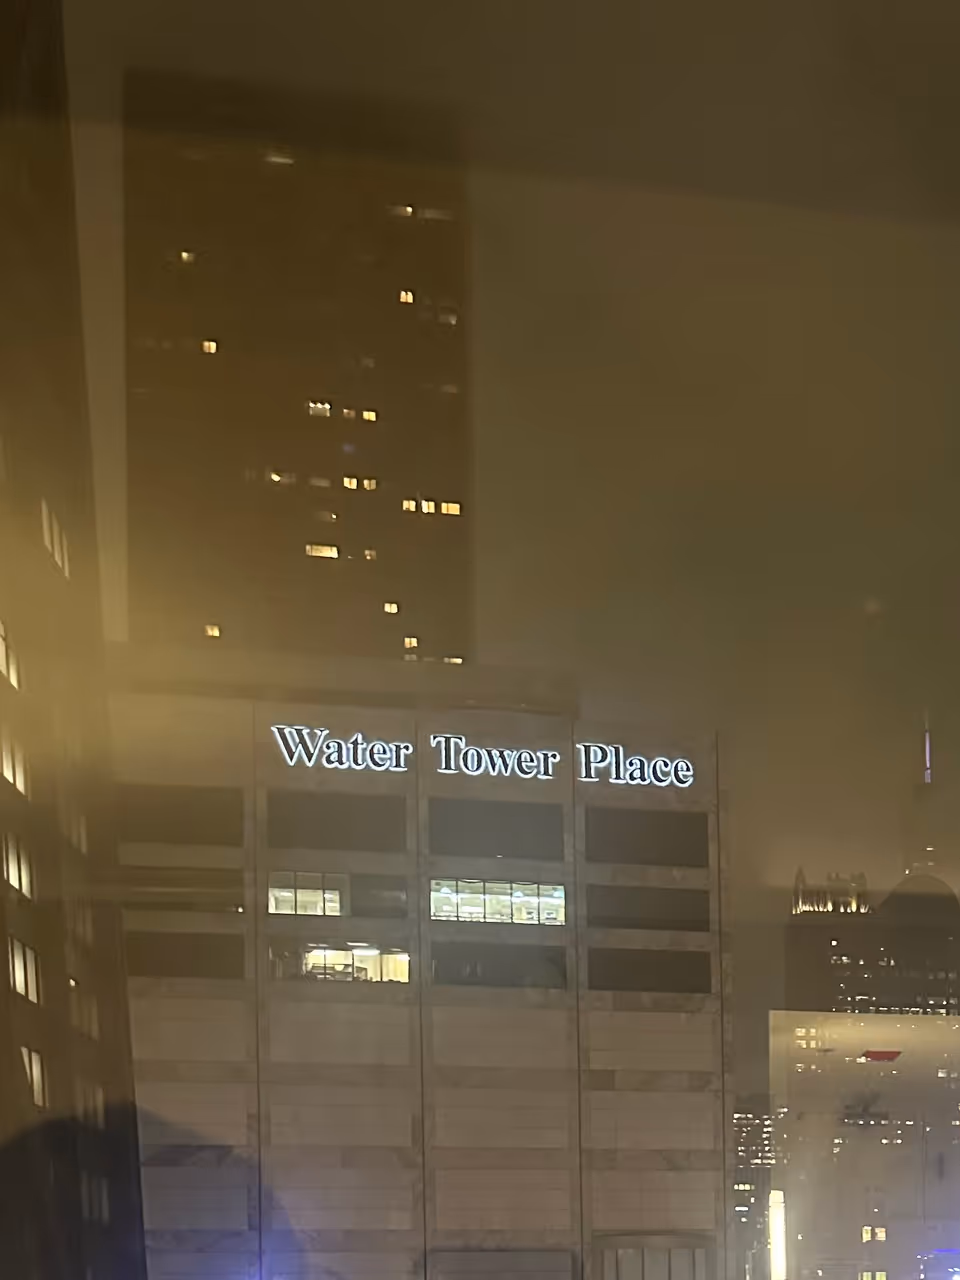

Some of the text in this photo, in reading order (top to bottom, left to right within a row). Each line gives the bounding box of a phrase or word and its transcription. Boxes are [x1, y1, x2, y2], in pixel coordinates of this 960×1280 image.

[270, 724, 694, 788] Water Tower Place
